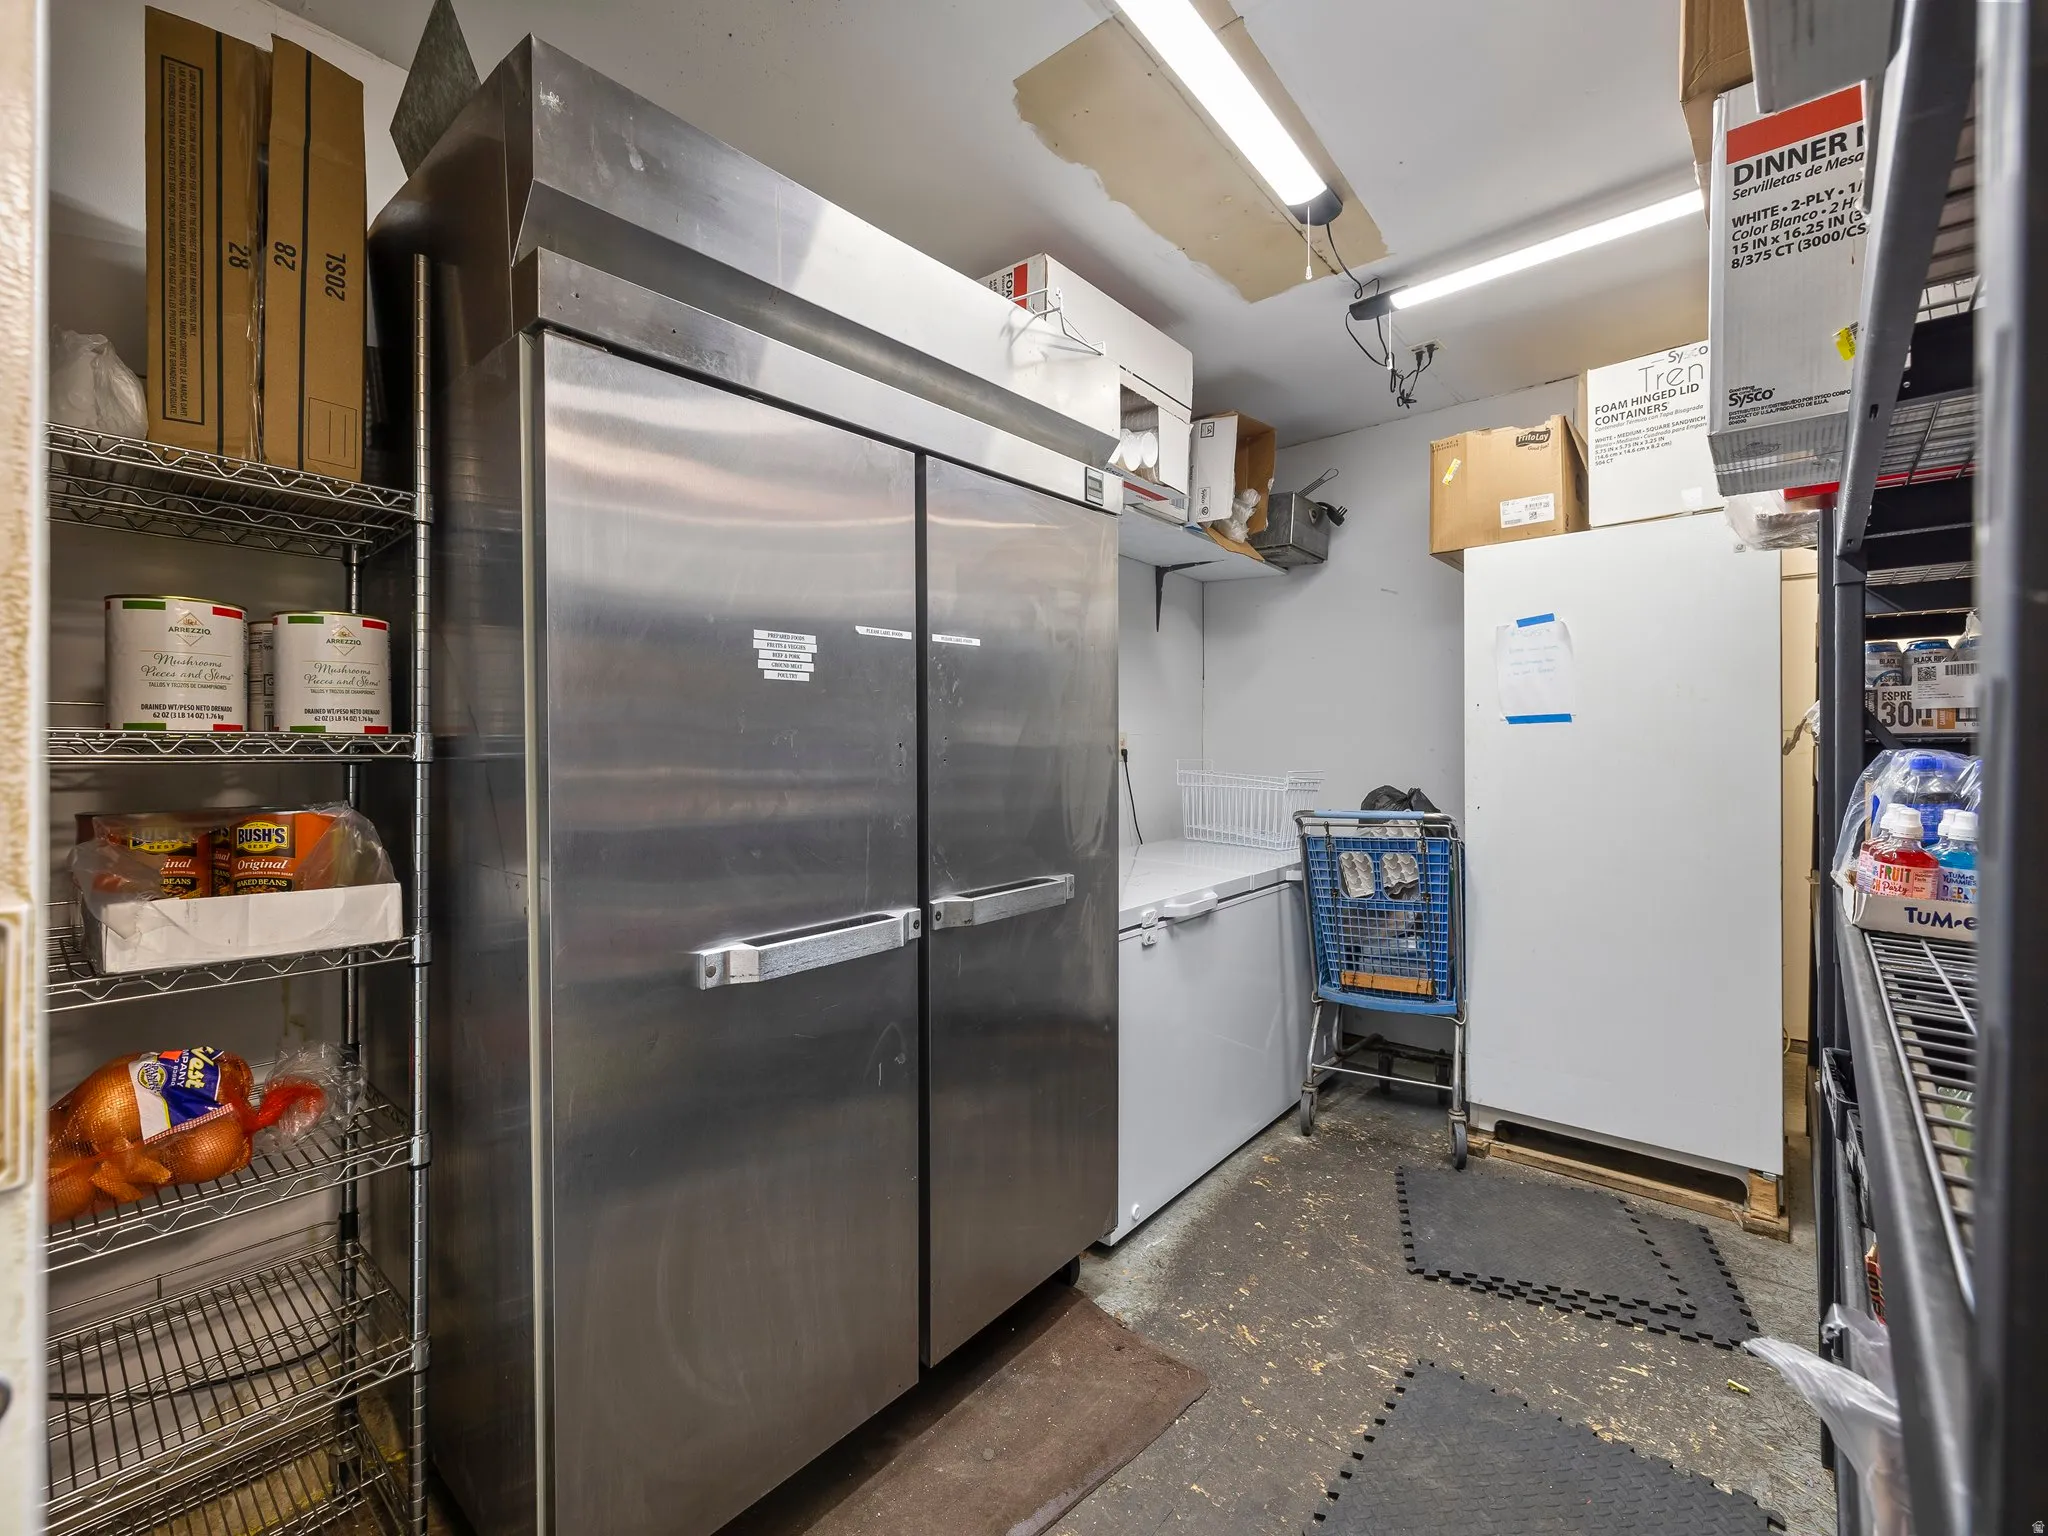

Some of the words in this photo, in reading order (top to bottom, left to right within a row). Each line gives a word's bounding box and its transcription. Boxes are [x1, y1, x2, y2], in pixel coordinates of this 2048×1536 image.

[1734, 132, 1847, 186] DINNER
[1732, 172, 1801, 200] Servilletas
[1805, 165, 1822, 178] de
[1825, 152, 1864, 172] Mesa
[1732, 205, 1779, 228] WHITE
[1792, 188, 1835, 211] 2-PLY
[1732, 224, 1768, 241] Color
[1770, 210, 1818, 231] Blanco
[1829, 202, 1838, 214] 2
[1732, 242, 1748, 255] 15
[1753, 236, 1767, 250] IN
[1771, 236, 1780, 244] x
[1784, 221, 1824, 240] 16.25
[1828, 214, 1845, 228] IN
[274, 242, 296, 271] 28
[1731, 250, 1772, 269] 8/375
[1775, 243, 1794, 256] CT
[325, 253, 346, 301] 20SL
[1595, 400, 1628, 415] FOAM
[1631, 388, 1676, 406] HINGED
[1680, 384, 1699, 395] LID
[1595, 402, 1668, 426] CONTAINERS
[1675, 404, 1704, 415] Bisagrada
[1617, 430, 1641, 438] MEDIUM
[1646, 423, 1670, 432] SQUARE
[1672, 416, 1705, 427] SANDWICH
[1644, 430, 1671, 439] Cuadrado
[168, 626, 210, 635] ARREZZIO
[154, 653, 221, 667] Mushrooms
[314, 662, 370, 675] Mushrooms
[141, 665, 175, 677] Pieces
[180, 670, 201, 678] and
[304, 674, 333, 684] Pieces
[1882, 691, 1912, 700] ESPRE
[238, 828, 285, 844] BUSH'S
[161, 859, 192, 870] inal
[238, 859, 288, 870] Original
[1880, 864, 1911, 883] FRUIT
[1882, 881, 1910, 895] Party
